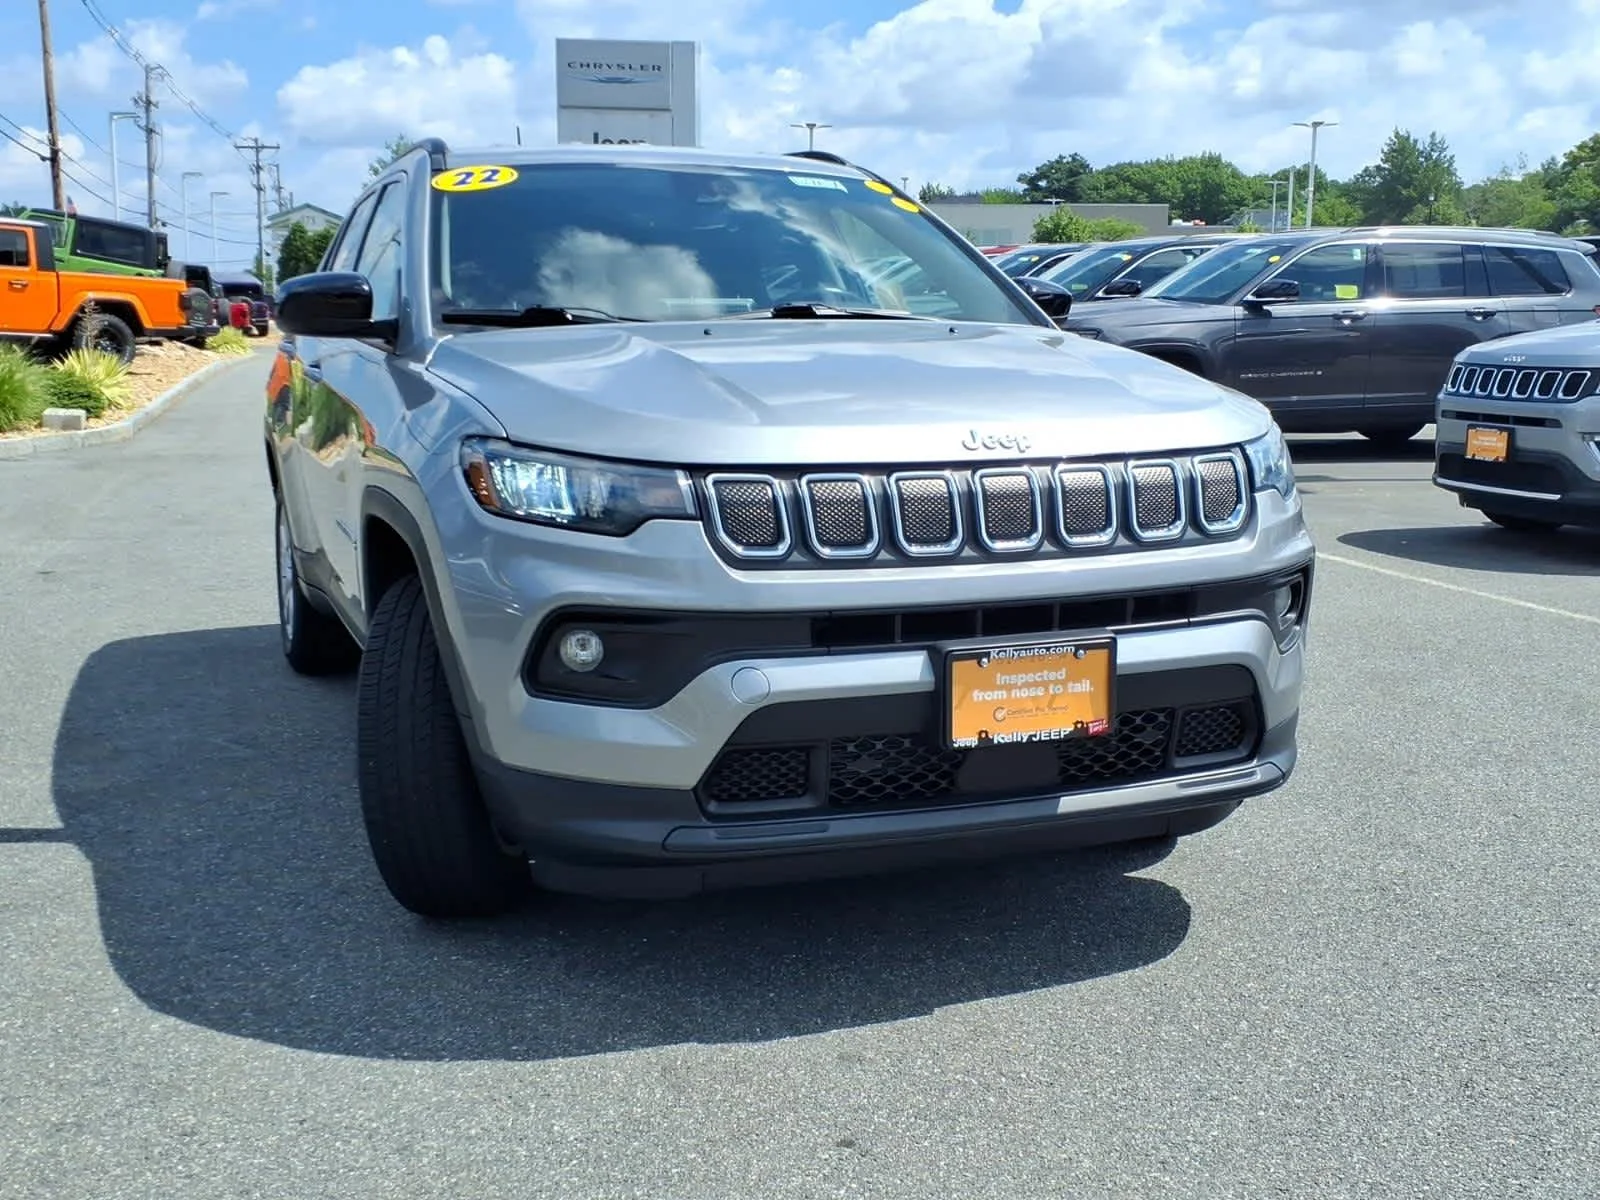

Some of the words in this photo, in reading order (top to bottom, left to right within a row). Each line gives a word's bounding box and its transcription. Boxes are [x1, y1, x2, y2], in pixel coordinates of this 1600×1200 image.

[567, 61, 662, 72] CHRYSLER
[453, 169, 501, 186] 22
[961, 429, 1032, 453] Jeep
[990, 645, 1075, 660] Kellyauto.com
[996, 667, 1066, 686] Inspected
[972, 688, 1007, 701] from
[1011, 685, 1045, 698] nose
[1049, 683, 1063, 695] to
[1068, 679, 1094, 693] tail.
[993, 730, 1032, 744] Kelly
[1032, 728, 1070, 741] JEEP
